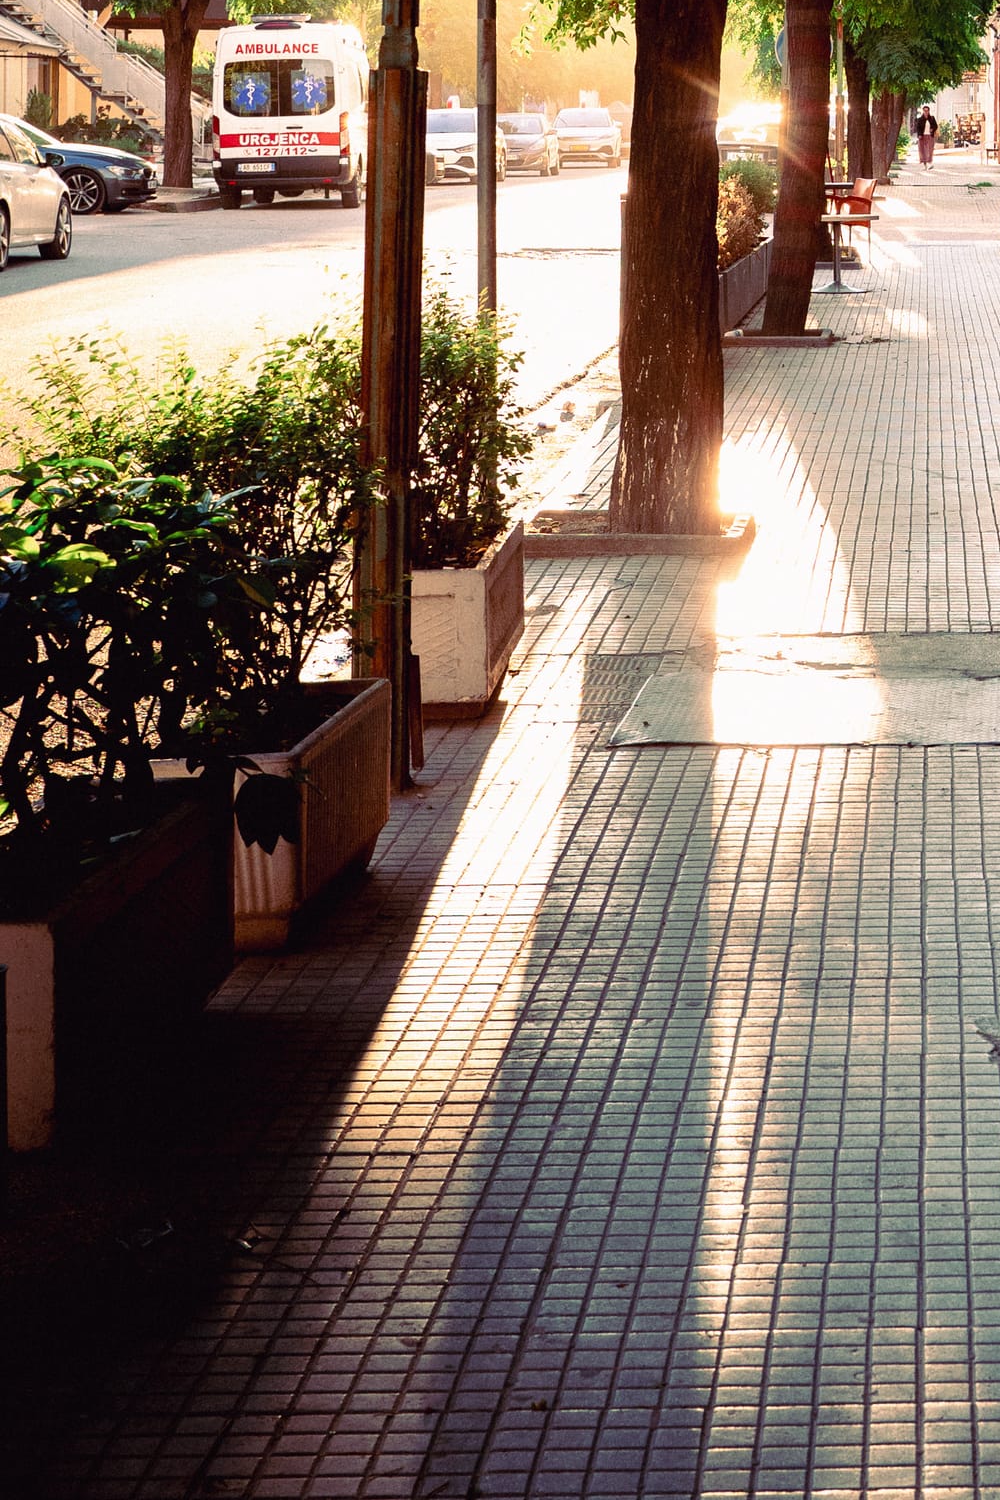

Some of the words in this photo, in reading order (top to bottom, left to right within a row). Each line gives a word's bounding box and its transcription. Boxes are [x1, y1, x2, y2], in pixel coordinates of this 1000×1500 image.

[235, 43, 319, 55] AMBULANCE
[239, 133, 320, 146] URGJENCA
[255, 147, 308, 156] 127/112
